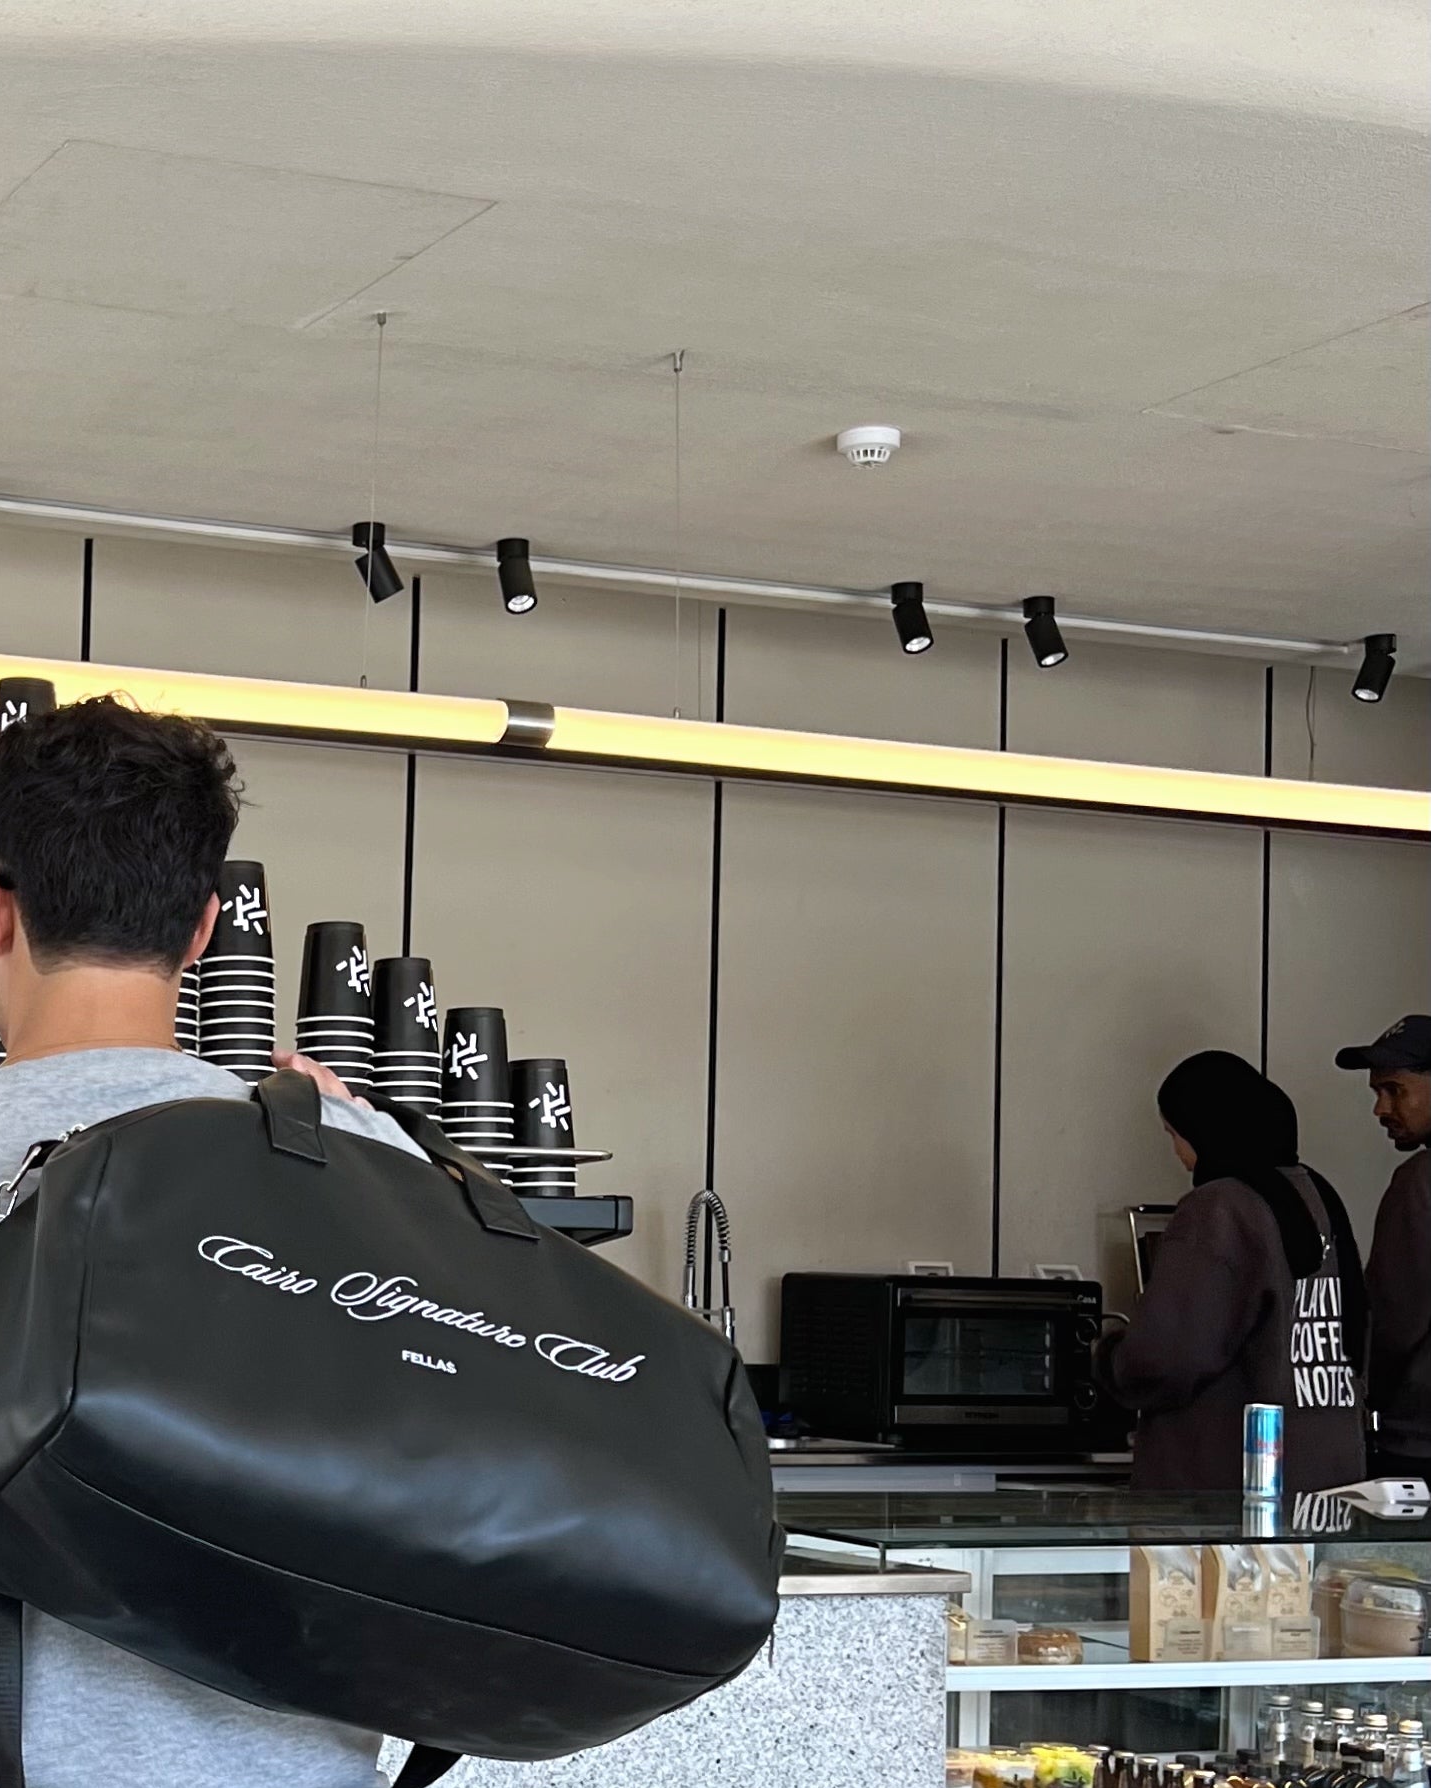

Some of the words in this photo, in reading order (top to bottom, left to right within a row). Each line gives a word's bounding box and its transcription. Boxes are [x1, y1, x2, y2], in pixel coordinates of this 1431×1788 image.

[197, 1235, 318, 1294] Cairo
[330, 1271, 527, 1348] Signature
[534, 1333, 646, 1382] Club
[401, 1349, 458, 1374] FELLAS
[1293, 1365, 1355, 1408] NOTES
